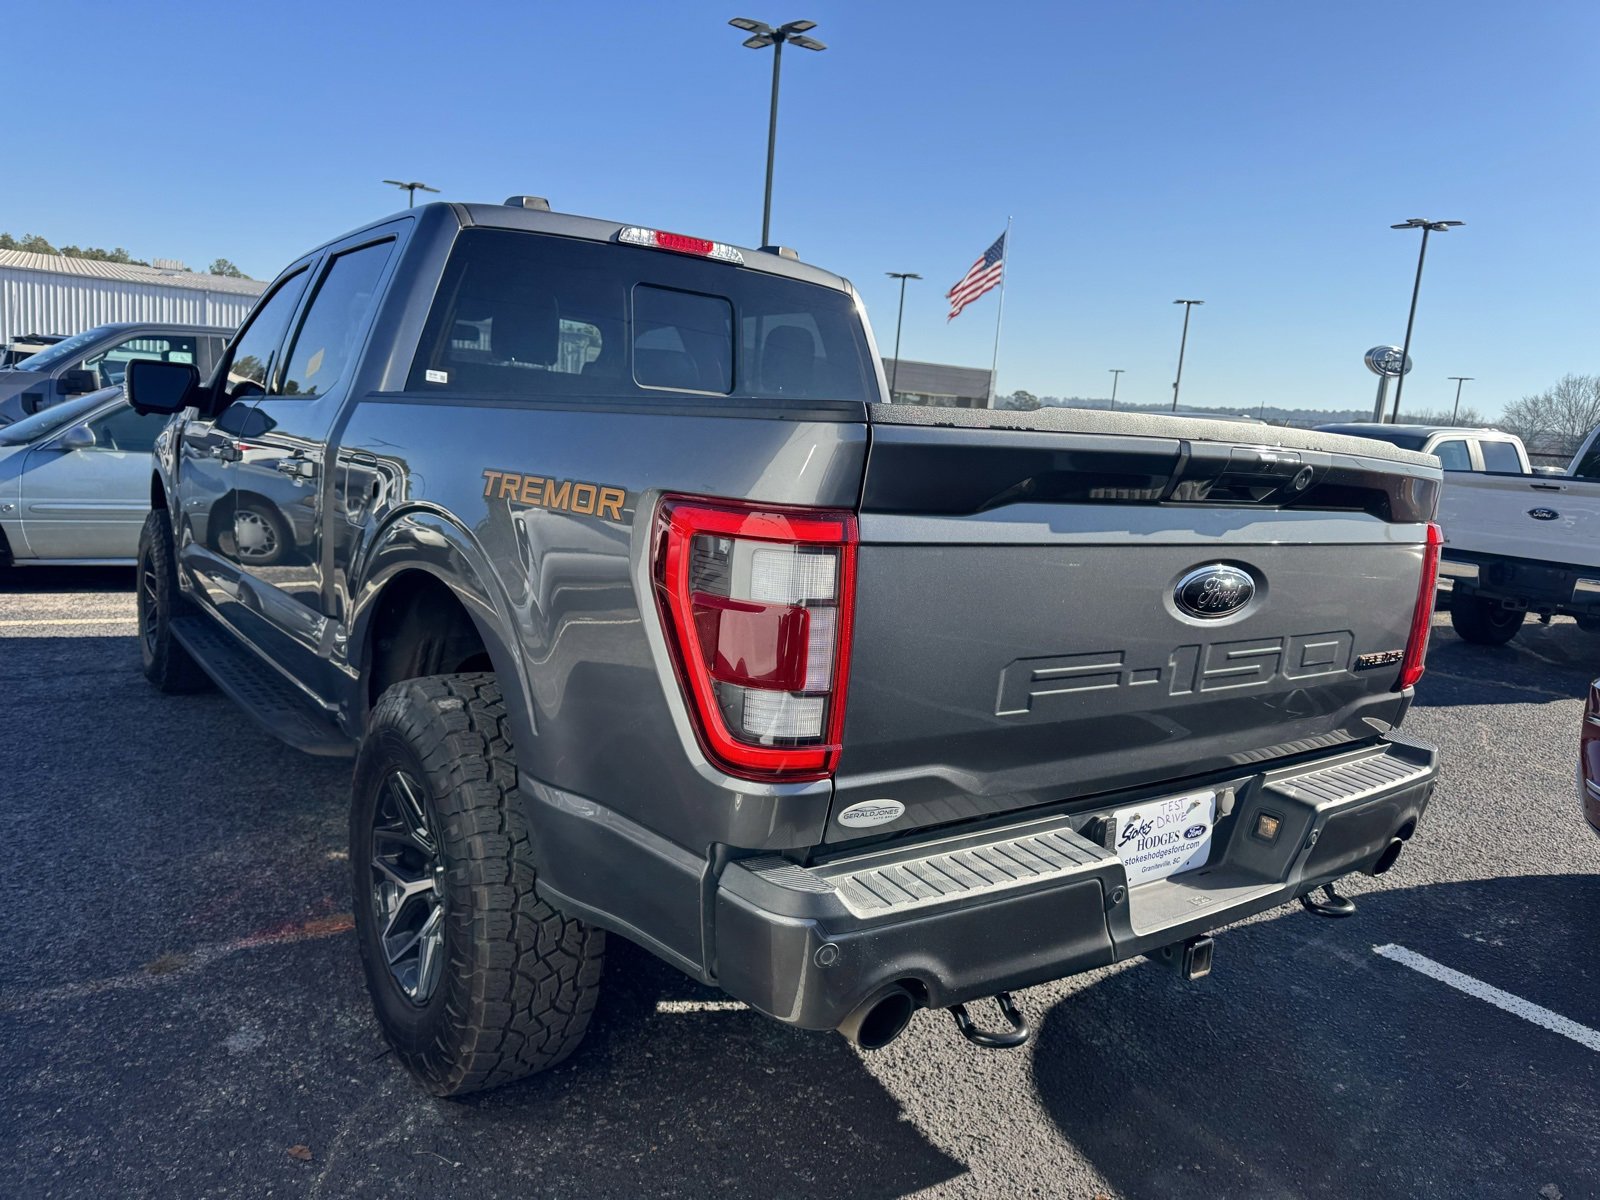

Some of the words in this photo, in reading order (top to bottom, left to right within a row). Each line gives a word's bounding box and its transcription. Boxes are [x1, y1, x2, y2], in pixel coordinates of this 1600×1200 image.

[483, 470, 626, 521] TREMOR
[1197, 577, 1242, 608] Ford
[995, 630, 1355, 716] F-150
[1160, 798, 1188, 815] TEST
[1156, 811, 1187, 828] DRIVE
[1118, 819, 1154, 847] Stokes
[1137, 830, 1180, 851] HODGES
[1187, 827, 1204, 838] Ford
[1124, 841, 1200, 866] stokeshodgesford.com
